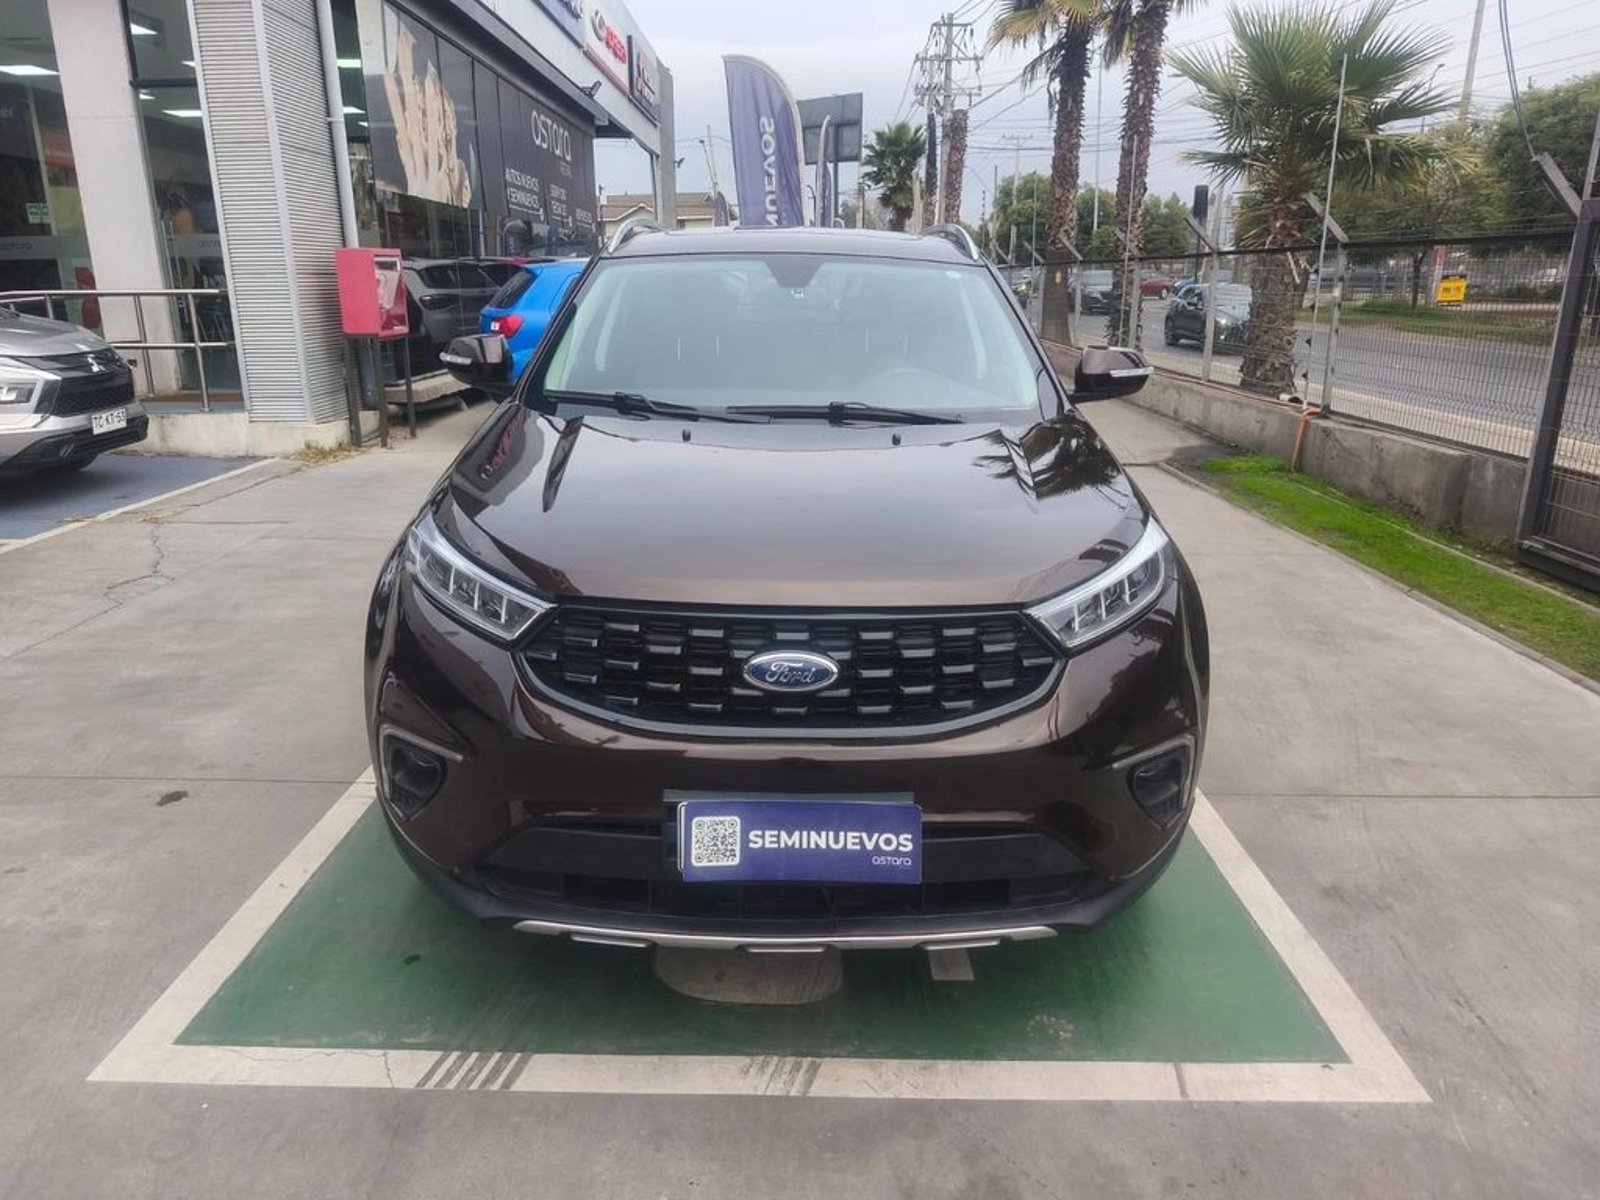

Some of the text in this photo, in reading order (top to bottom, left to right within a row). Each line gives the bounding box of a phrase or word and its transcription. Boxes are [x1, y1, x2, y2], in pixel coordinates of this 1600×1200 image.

[765, 660, 815, 684] Ford
[748, 829, 913, 852] SEMINUEVOS
[872, 856, 912, 867] astara
